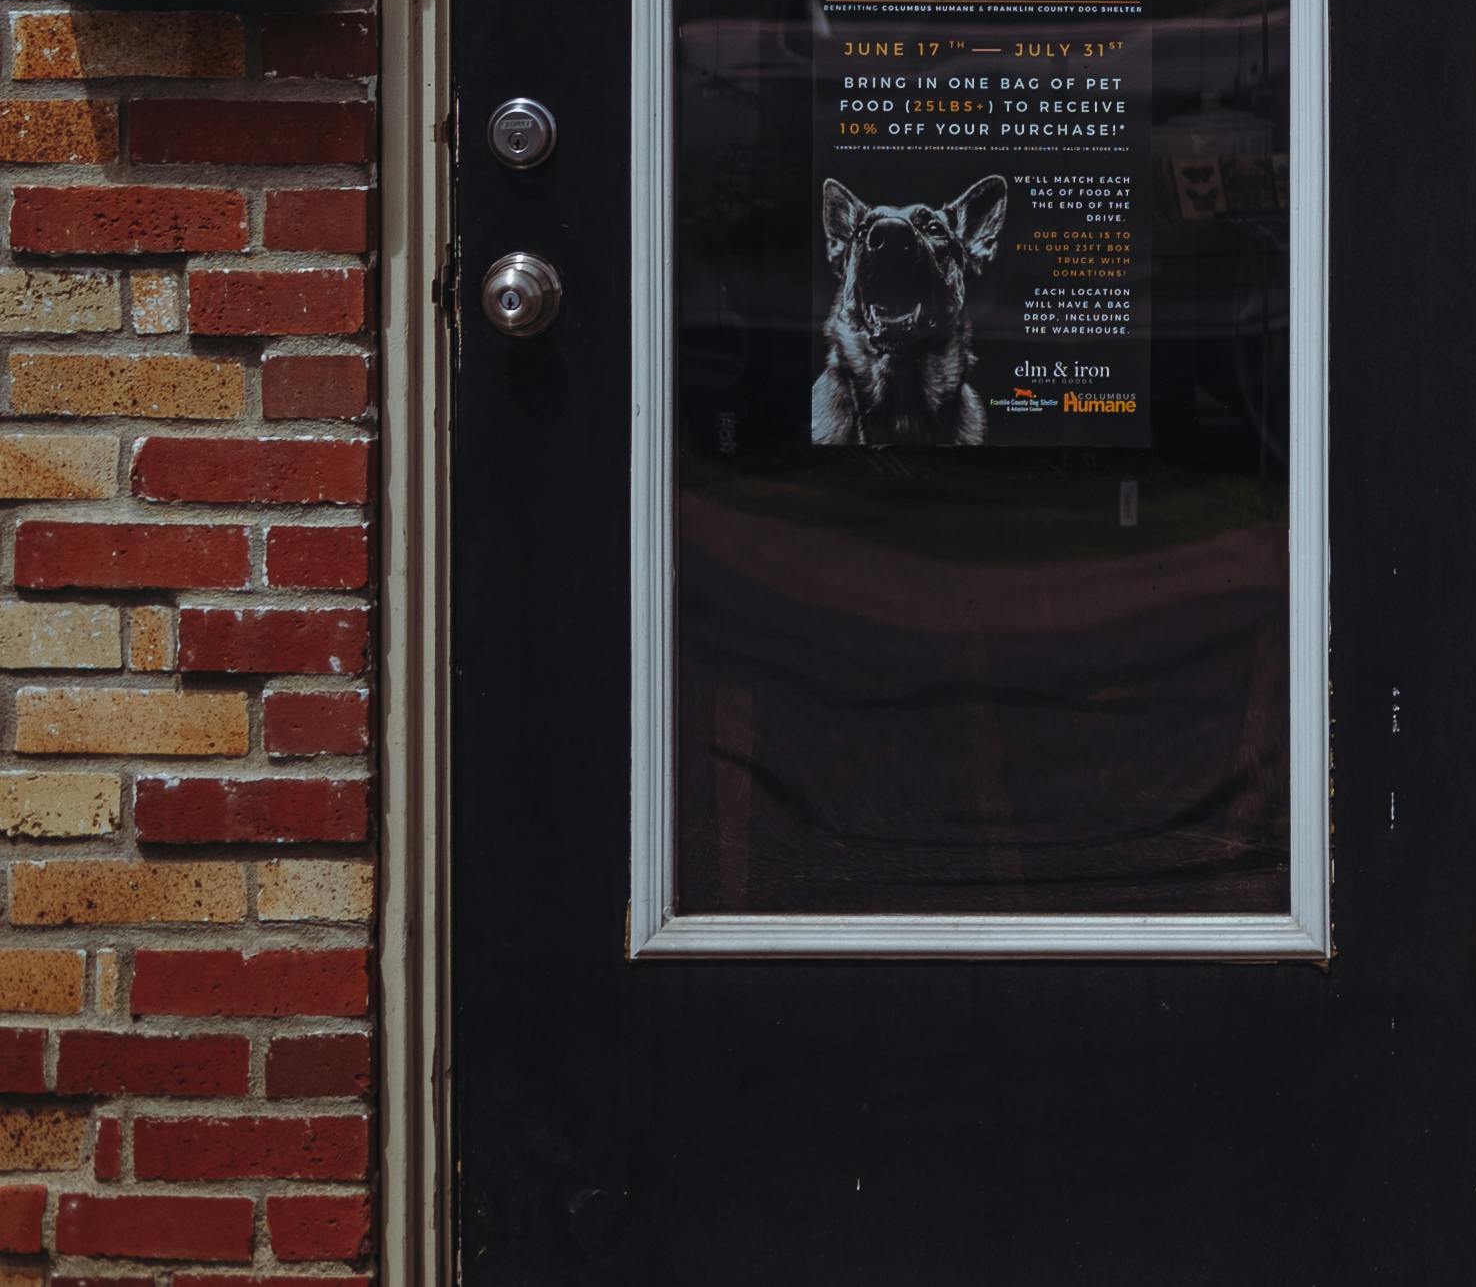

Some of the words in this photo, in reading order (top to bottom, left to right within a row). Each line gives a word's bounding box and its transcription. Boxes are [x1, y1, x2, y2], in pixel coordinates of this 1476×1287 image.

[844, 43, 904, 56] JUNE
[917, 43, 940, 56] 17
[1015, 43, 1072, 57] JULY
[845, 77, 905, 88] BRING
[919, 77, 936, 88] IN
[949, 78, 988, 89] ONE
[1001, 78, 1038, 89] BAG
[1051, 78, 1074, 89] OF
[1087, 79, 1121, 89] PET
[841, 100, 893, 111] FOOD
[906, 100, 992, 113] (25LBS+)
[1004, 101, 1027, 112] TO
[1040, 101, 1124, 112] RECEIVE
[840, 123, 877, 134] 10%
[889, 123, 924, 134] OFF
[936, 124, 988, 135] YOUR
[1015, 361, 1046, 377] elm
[1054, 361, 1068, 377] &
[1075, 361, 1110, 377] iron
[1064, 392, 1136, 413] Humane
